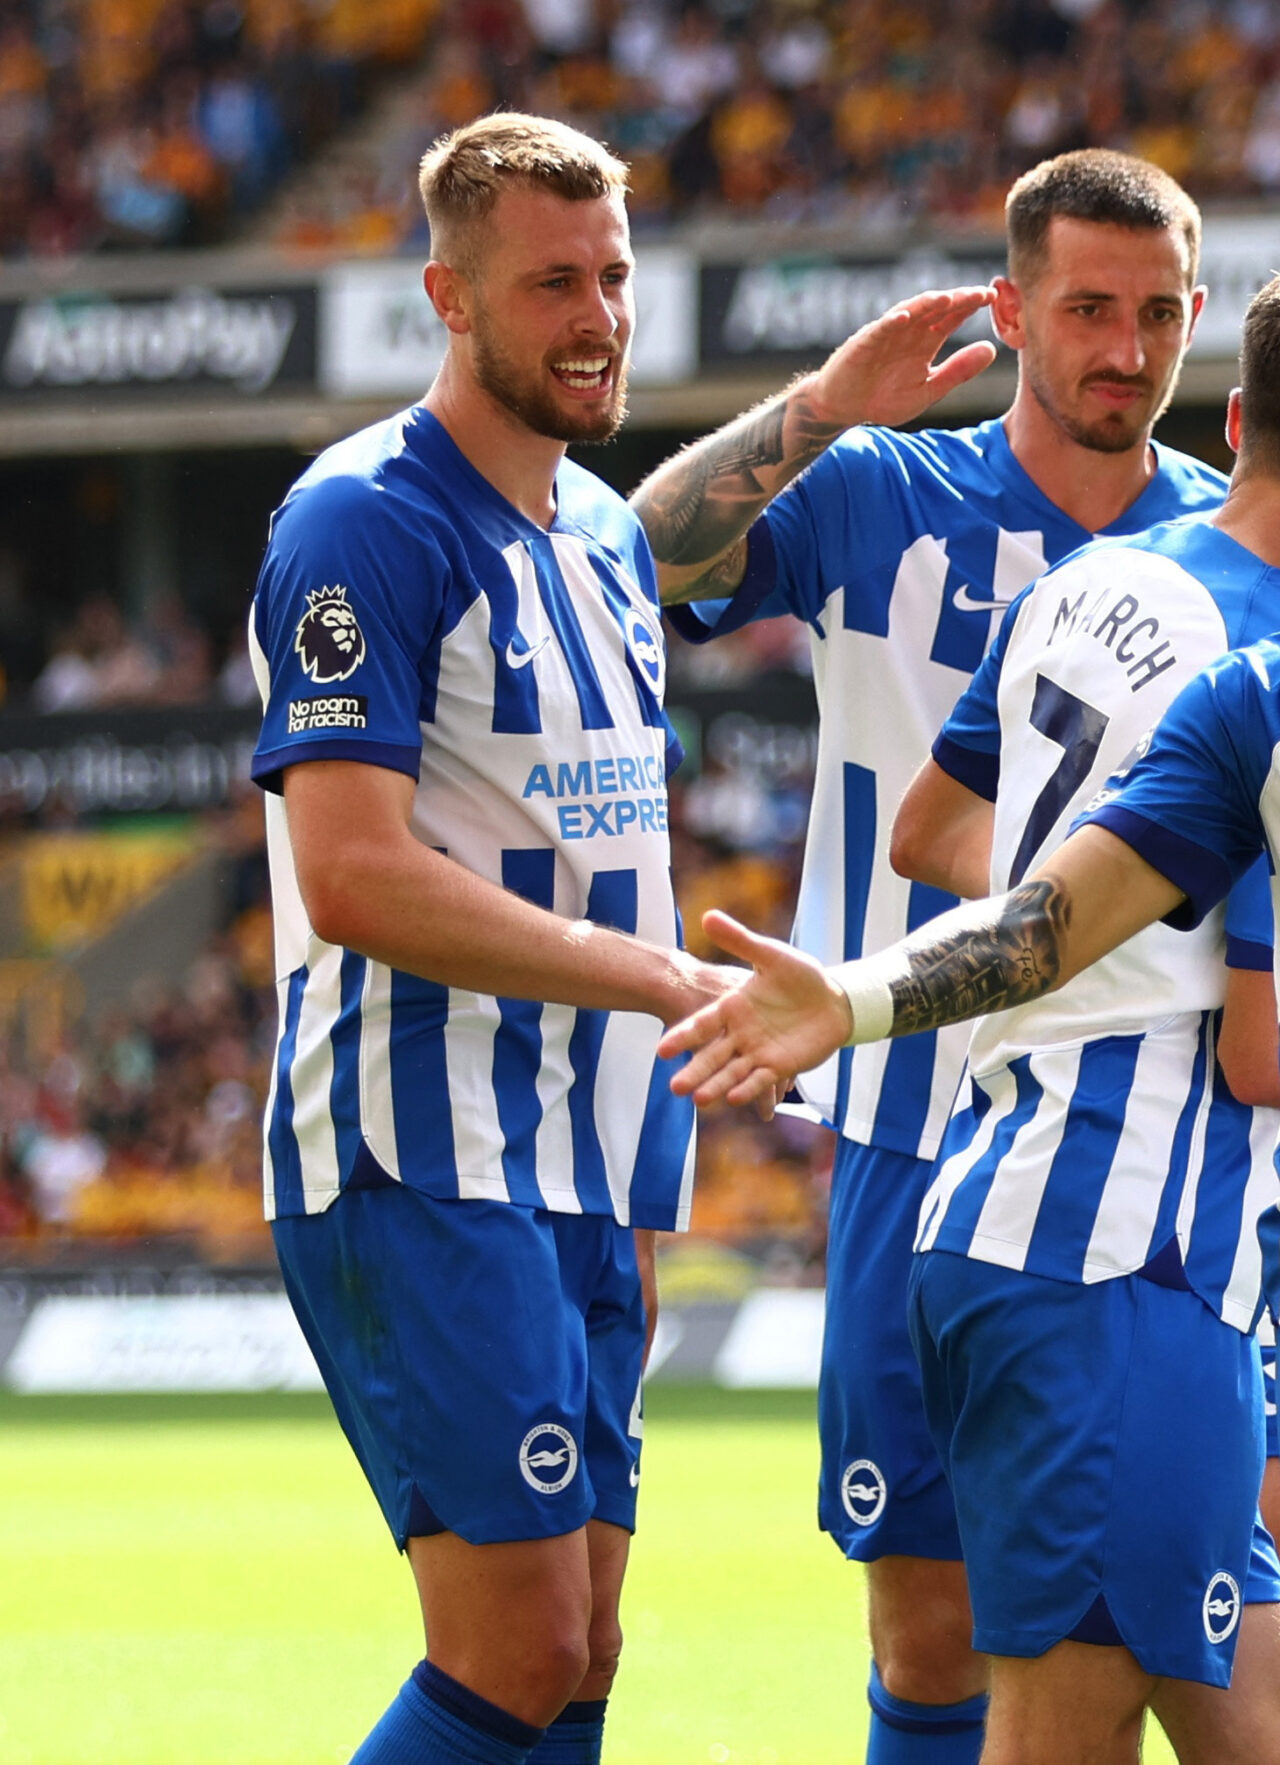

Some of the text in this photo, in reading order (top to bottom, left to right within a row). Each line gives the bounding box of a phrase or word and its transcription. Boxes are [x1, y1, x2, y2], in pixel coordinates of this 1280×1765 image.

[1046, 587, 1176, 693] MARCH
[289, 697, 359, 718] No room
[309, 712, 366, 729] racism
[1008, 672, 1111, 891] 7
[557, 798, 667, 840] EXPRE
